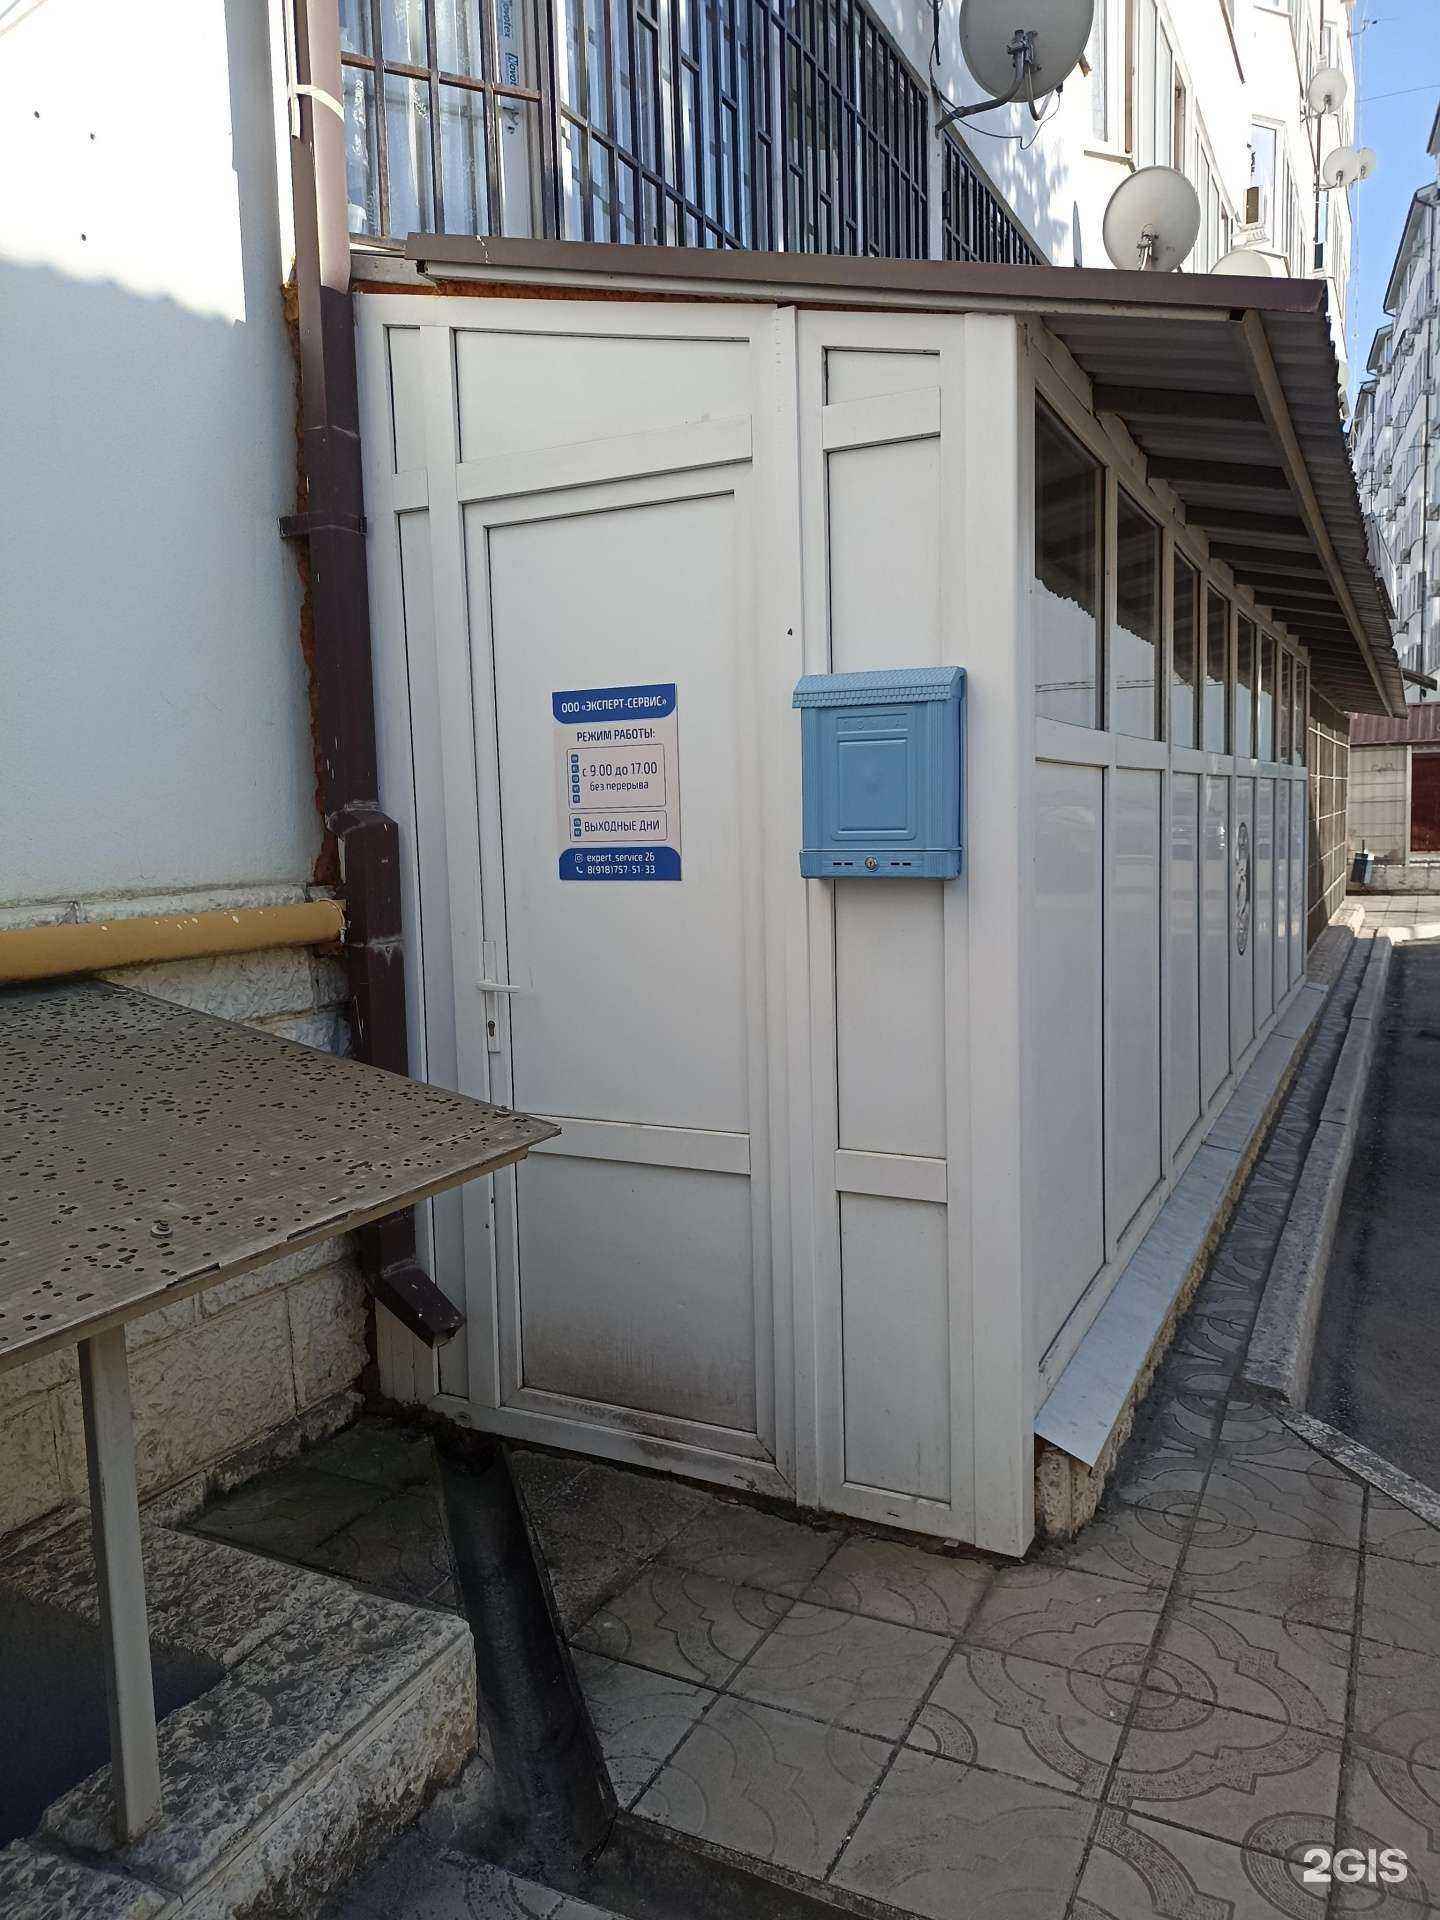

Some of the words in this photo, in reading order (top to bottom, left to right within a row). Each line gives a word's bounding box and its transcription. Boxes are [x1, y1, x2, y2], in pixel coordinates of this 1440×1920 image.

[502, 0, 514, 39] ovotex
[561, 702, 580, 713] ООО
[582, 695, 667, 712] «ЭКСПЕРТ-СЕРВИС»
[576, 730, 612, 742] РЕЖИМ
[614, 727, 656, 740] РАБОТЫ:
[582, 768, 587, 777] с
[589, 763, 613, 777] 9.00
[614, 766, 629, 777] до
[630, 761, 658, 775] 17.00
[589, 781, 605, 791] без
[606, 781, 649, 791] перерыва
[584, 820, 637, 832] ВЫХОДНЫЕ
[638, 819, 660, 832] ДНИ
[587, 865, 656, 875] 8(918)757-51-33
